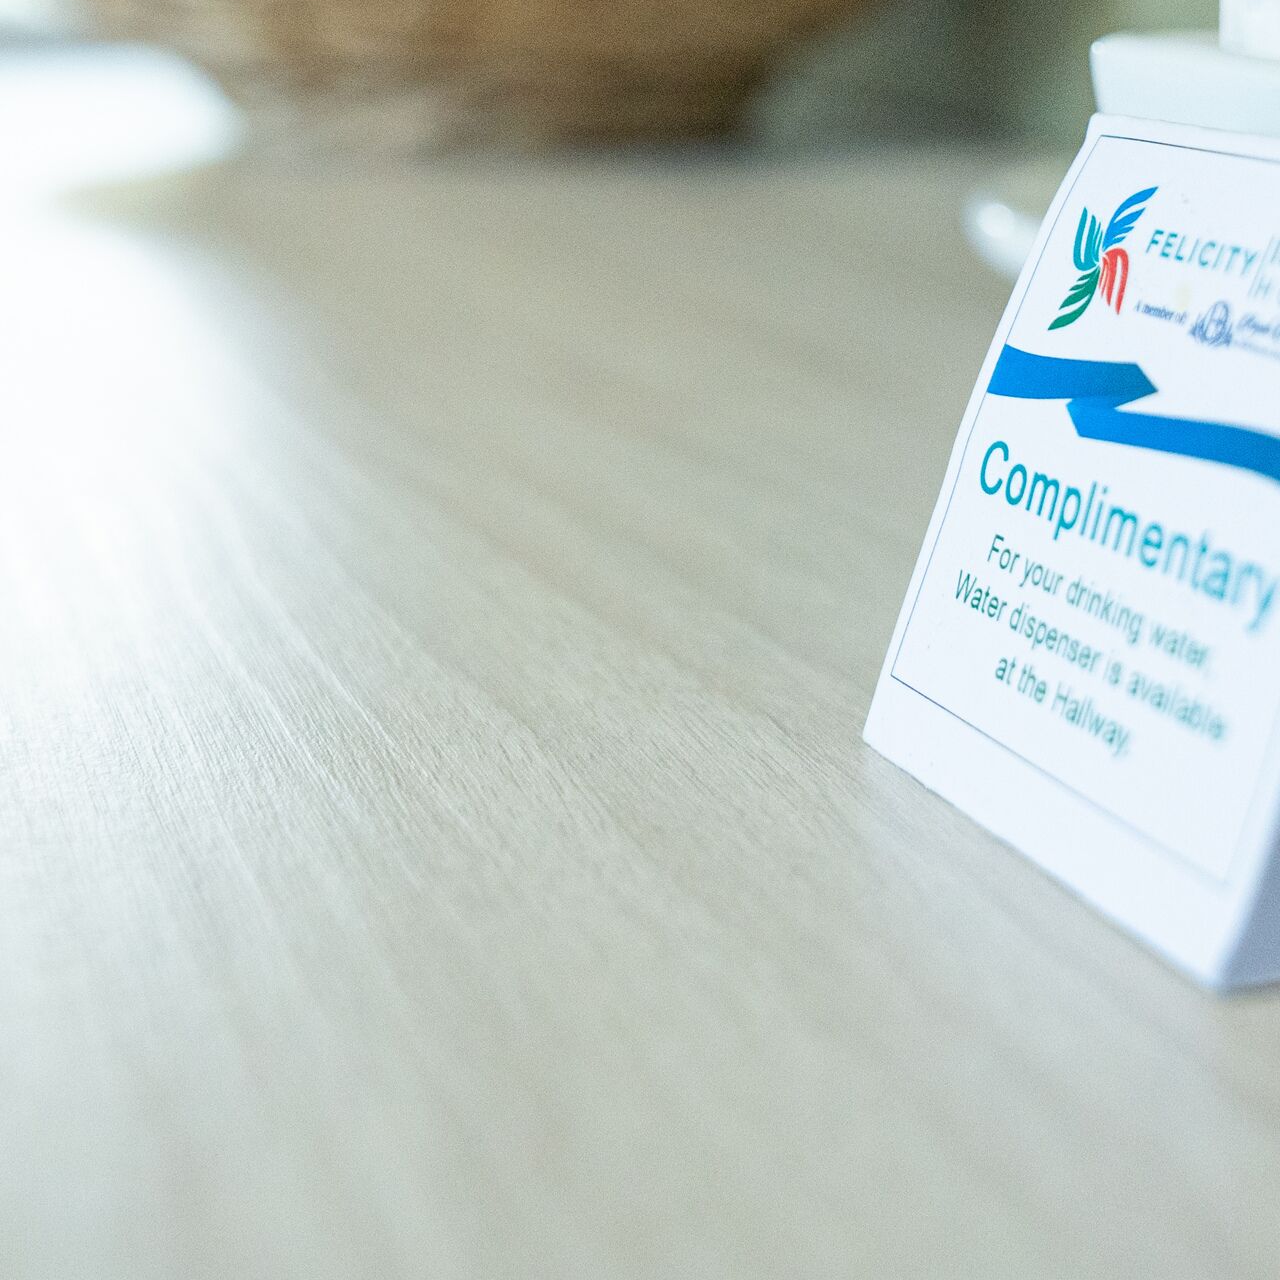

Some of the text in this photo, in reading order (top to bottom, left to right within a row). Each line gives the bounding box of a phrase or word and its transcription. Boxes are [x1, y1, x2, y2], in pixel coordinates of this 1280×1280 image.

[1145, 229, 1258, 276] FELICITY
[987, 534, 1020, 574] For
[1018, 558, 1064, 597] your
[1066, 576, 1144, 646] drinking
[954, 569, 1227, 742] Water dispenser is available
[994, 656, 1017, 686] at
[1016, 663, 1047, 703] the
